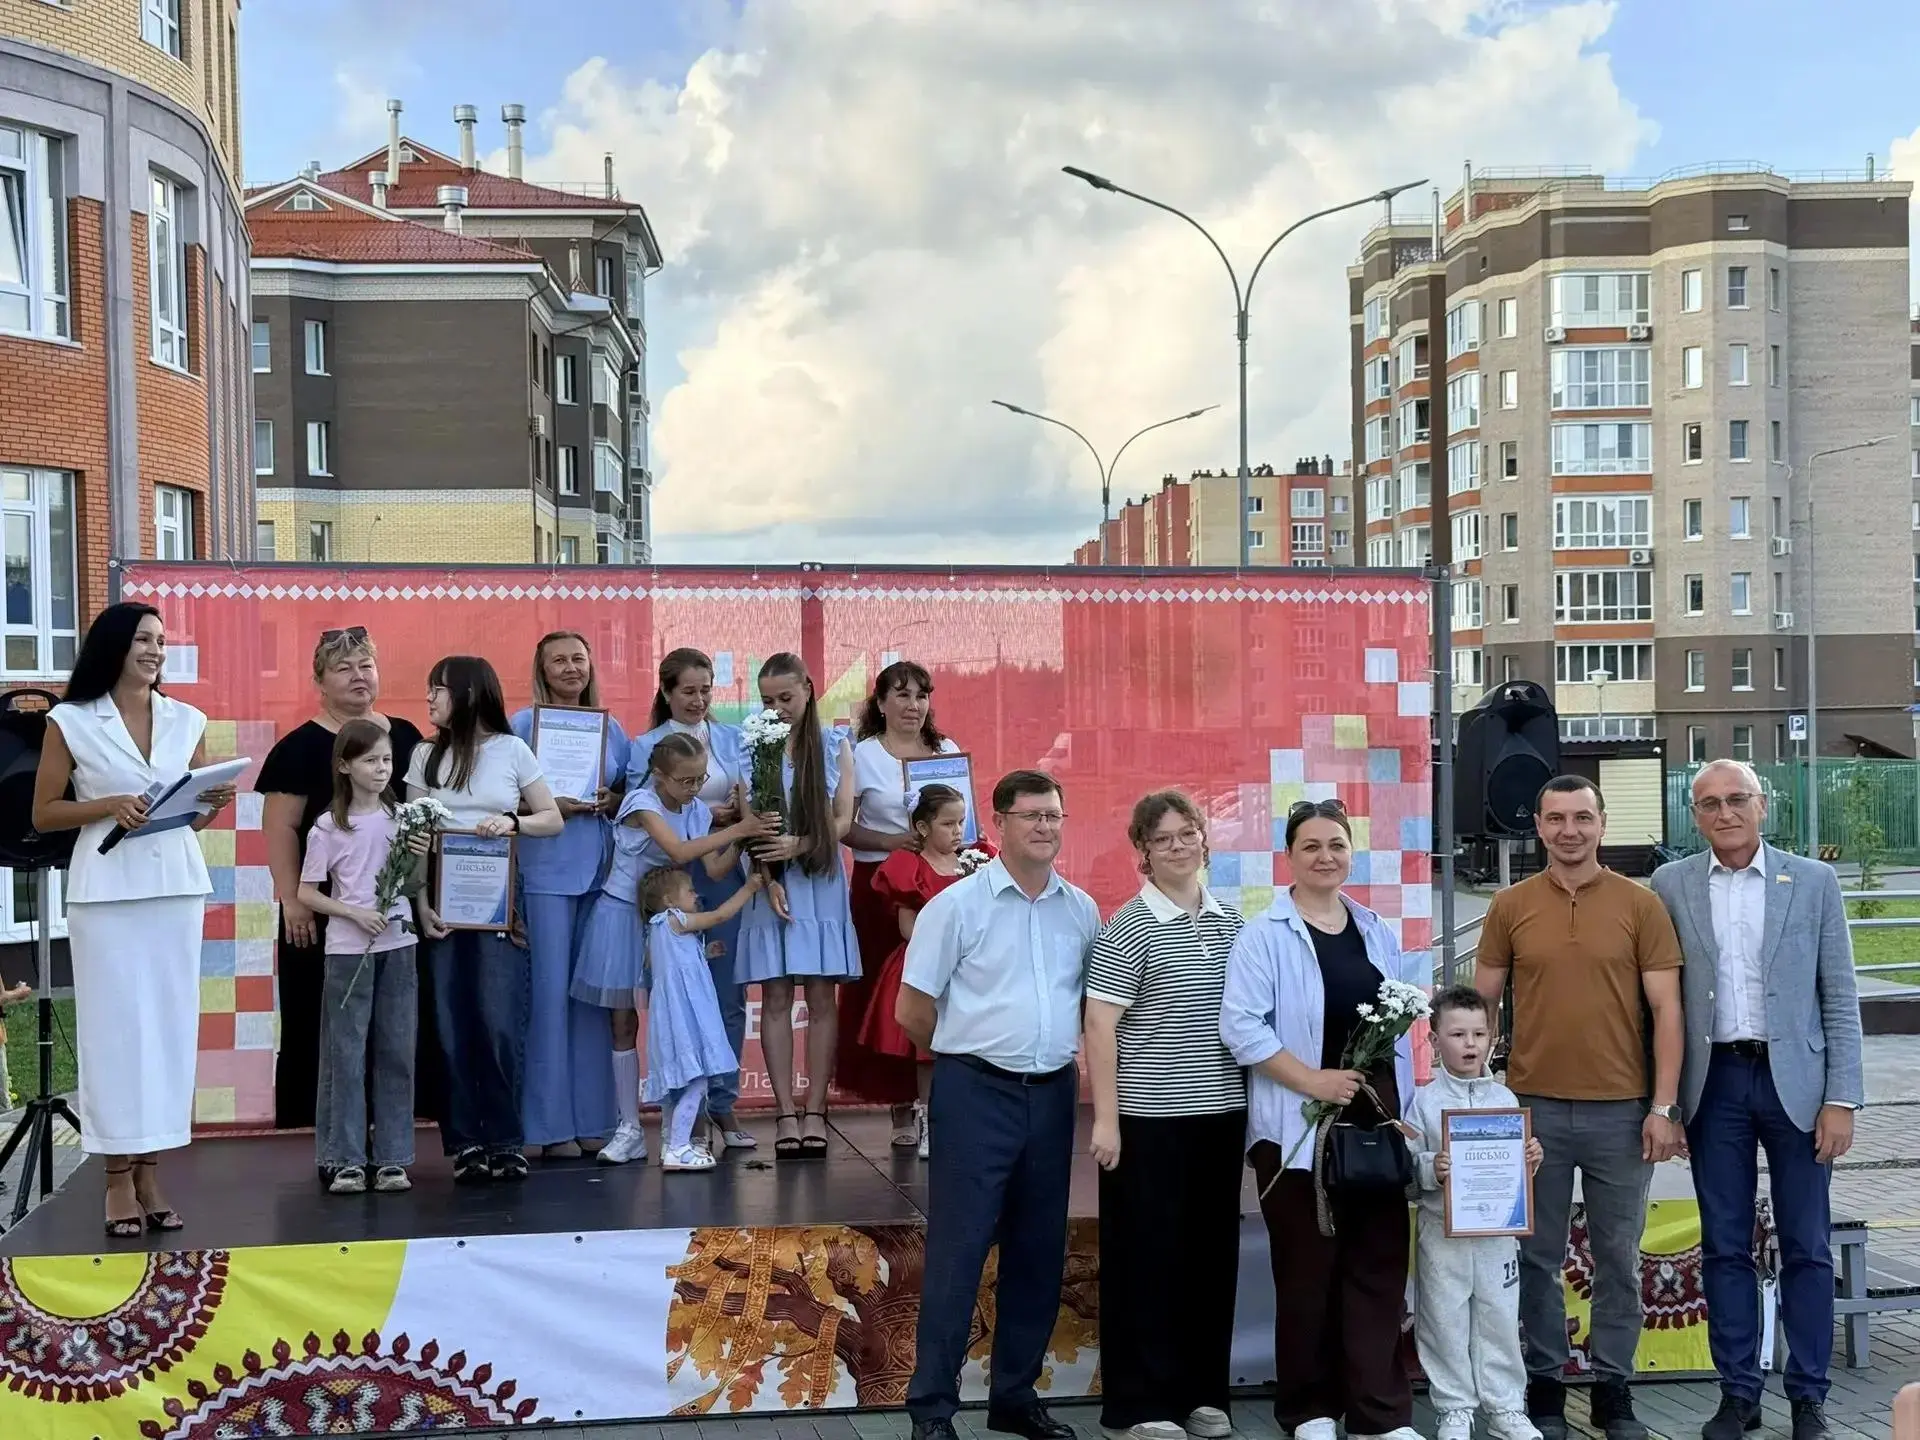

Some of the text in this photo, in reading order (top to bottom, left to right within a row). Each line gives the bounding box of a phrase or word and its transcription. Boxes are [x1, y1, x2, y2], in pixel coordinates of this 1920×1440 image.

[1793, 717, 1804, 731] P
[456, 863, 497, 872] ПИСЬМО
[1465, 1151, 1511, 1161] ПИСЬМО
